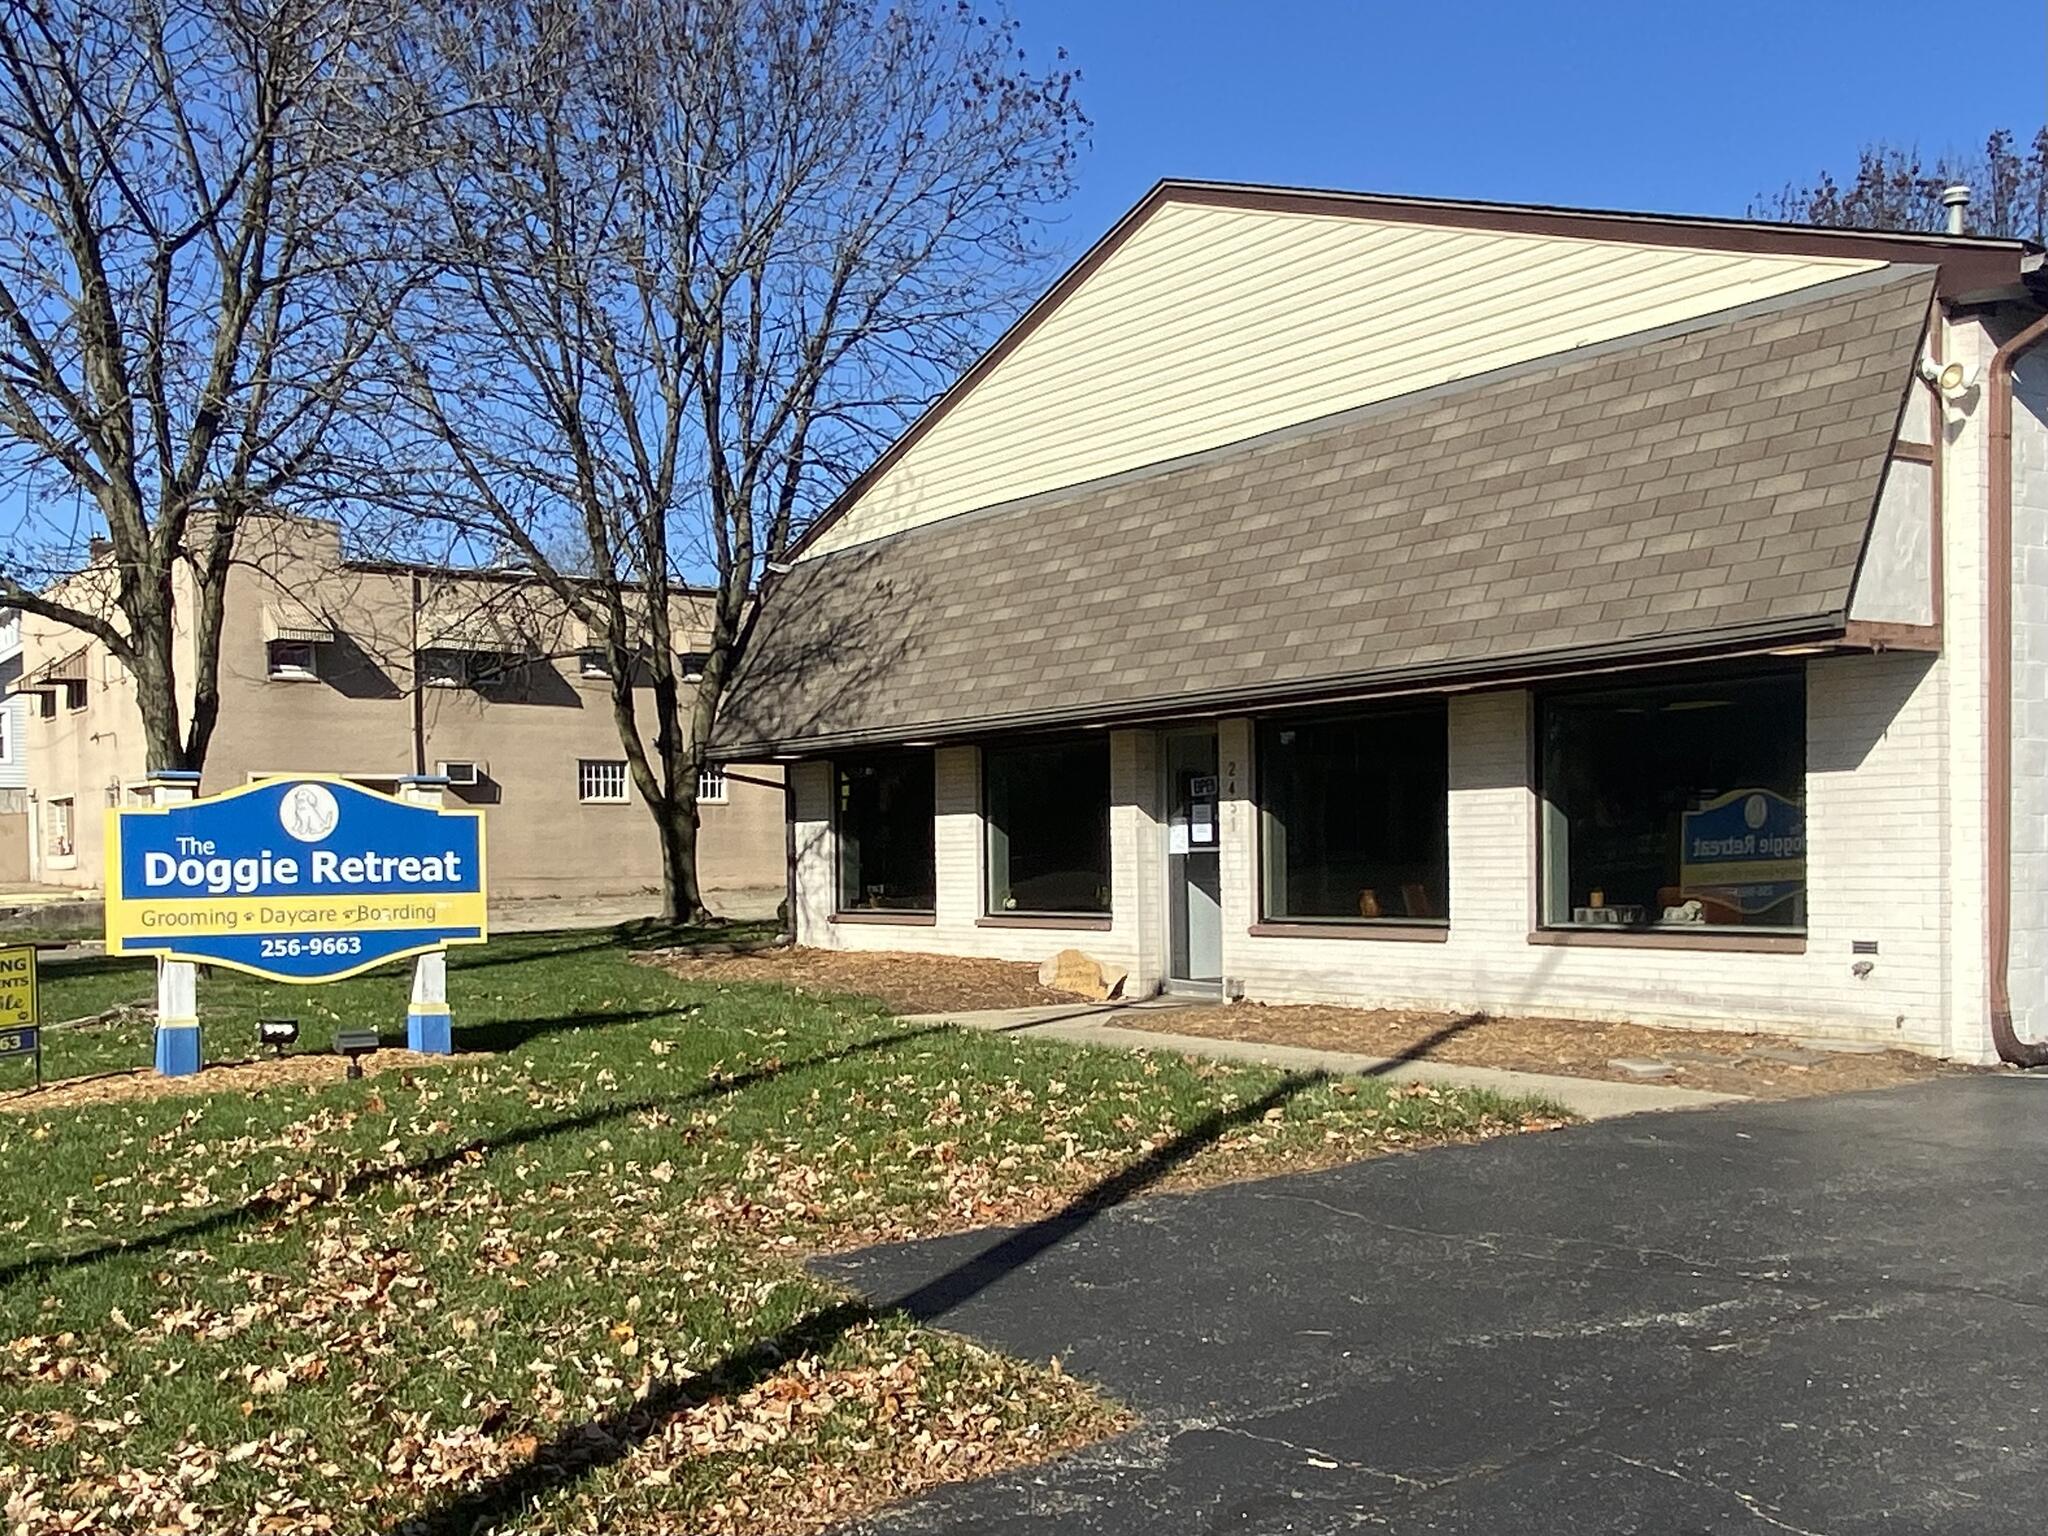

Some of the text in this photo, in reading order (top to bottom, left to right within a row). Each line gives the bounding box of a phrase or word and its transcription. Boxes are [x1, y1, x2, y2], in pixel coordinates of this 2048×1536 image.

[175, 836, 216, 856] The
[144, 849, 462, 893] Doggie Retreat
[141, 908, 238, 928] Grooming
[259, 906, 337, 927] Daycare
[260, 937, 362, 958] 256-9663
[0, 976, 29, 988] NTS
